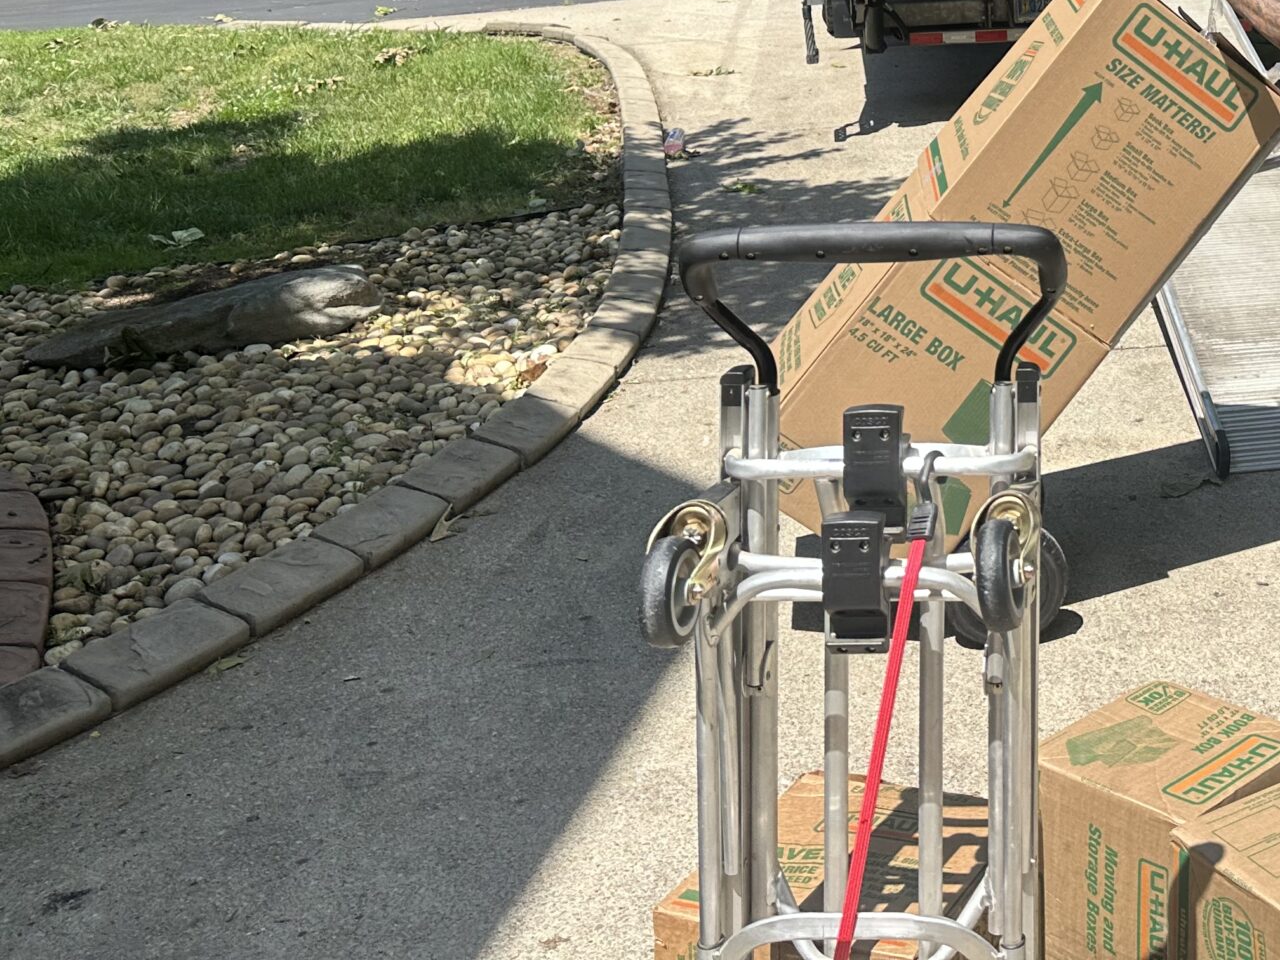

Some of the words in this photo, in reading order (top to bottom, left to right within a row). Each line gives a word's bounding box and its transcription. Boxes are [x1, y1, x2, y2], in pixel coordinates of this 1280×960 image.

[1131, 13, 1249, 112] U-HAUL
[1104, 55, 1145, 91] SIZE
[1138, 81, 1216, 146] MATTERS!
[1147, 112, 1164, 126] Book
[1162, 123, 1175, 135] Box
[1125, 141, 1143, 156] Small
[1141, 153, 1155, 165] Box
[1102, 169, 1127, 190] Medium
[1125, 186, 1138, 198] Box
[1079, 198, 1098, 215] Large
[1096, 210, 1110, 222] Box
[1057, 227, 1092, 255] Extra-Large
[1090, 251, 1103, 262] Box
[846, 325, 867, 344] 4.5
[865, 337, 883, 354] CU
[881, 348, 898, 364] FT
[857, 314, 874, 330] 18"
[878, 329, 896, 345] 18"
[866, 294, 928, 346] LARGE
[924, 335, 965, 372] BOX
[1136, 690, 1165, 706] OK
[1194, 720, 1210, 729] FT
[1205, 713, 1221, 721] CU
[1214, 713, 1257, 737] BOOK
[1190, 736, 1223, 754] BOX
[1181, 741, 1278, 800] U-HAUL
[1085, 821, 1101, 896] Storage
[1101, 843, 1117, 914] Moving
[1086, 898, 1099, 955] Boxes
[1149, 869, 1164, 953] U-HAU
[1103, 916, 1117, 956] and
